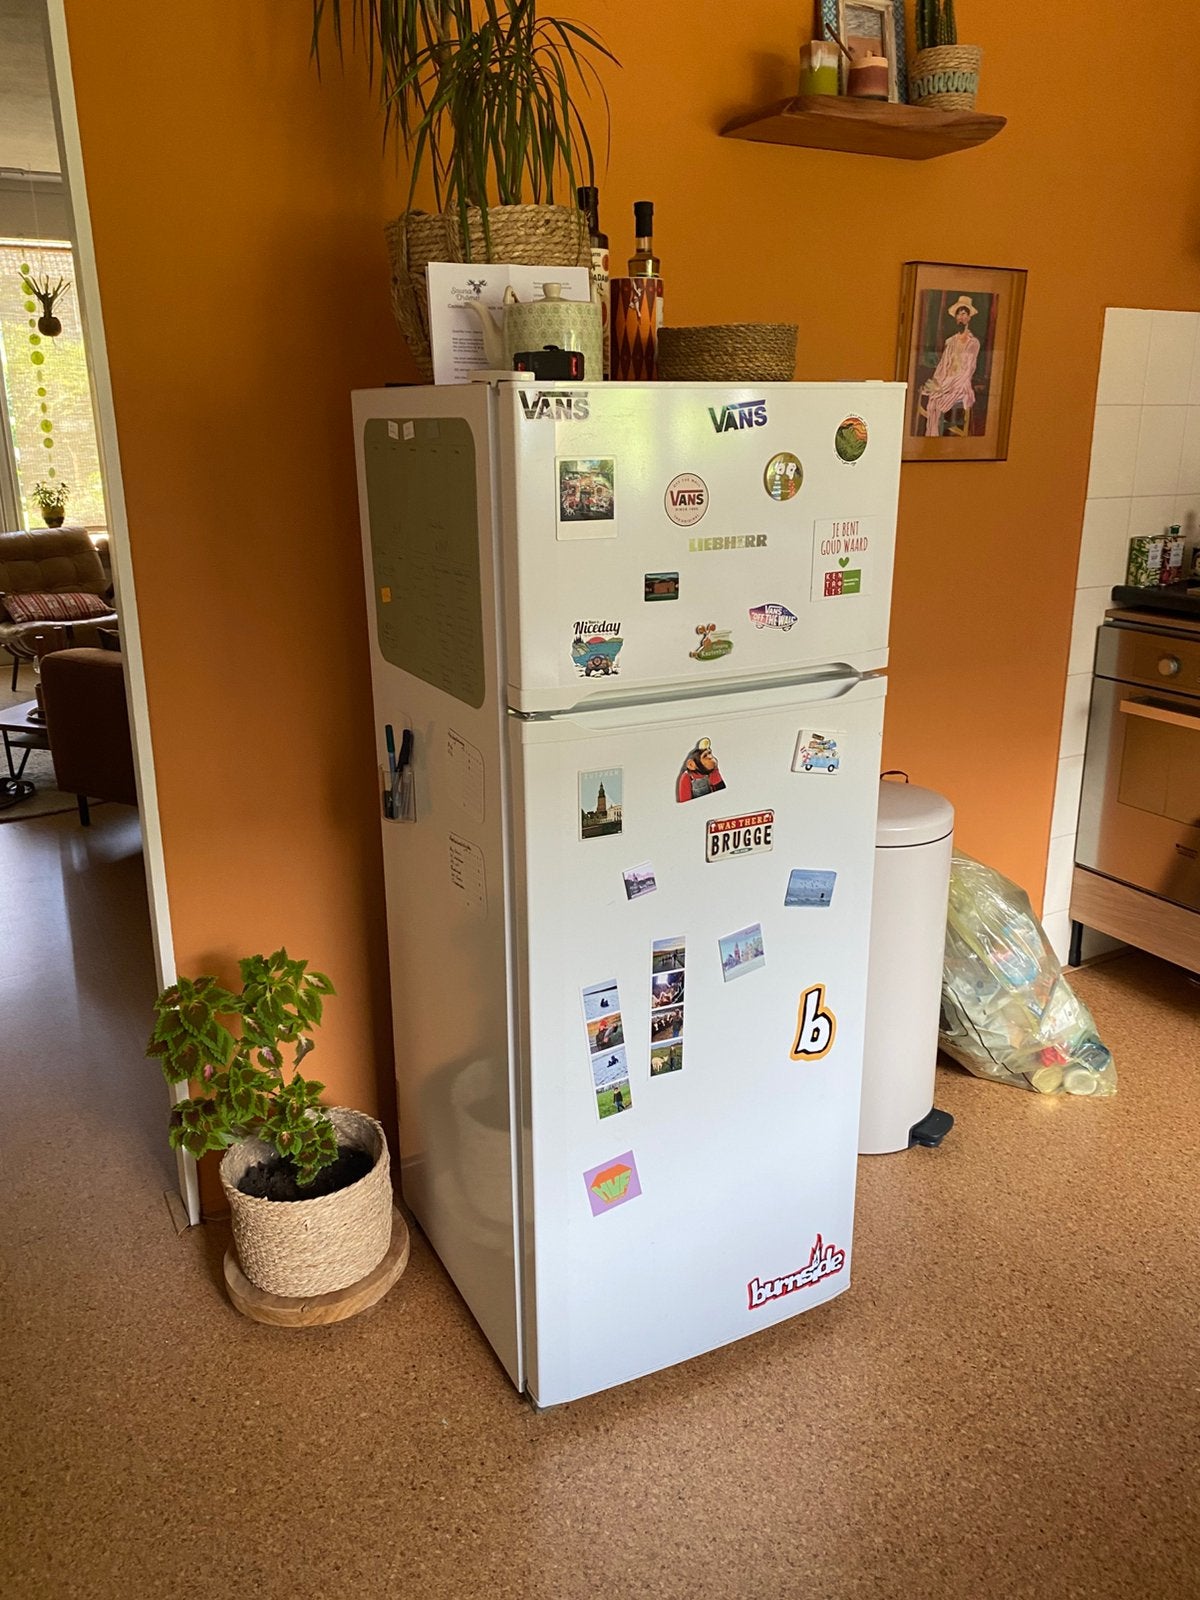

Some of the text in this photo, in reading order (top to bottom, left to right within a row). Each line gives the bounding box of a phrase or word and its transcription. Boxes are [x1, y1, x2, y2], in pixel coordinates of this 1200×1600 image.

[518, 391, 590, 420] VANS
[708, 399, 768, 433] VANS
[670, 490, 704, 506] VANS
[832, 521, 859, 539] JE BENT
[689, 534, 767, 552] LIEBHERR
[821, 537, 868, 555] GOUD WAARD
[765, 605, 783, 615] VANS
[573, 620, 621, 635] Niceday
[718, 821, 736, 831] WAS
[711, 825, 772, 856] BRUGGE
[748, 1240, 845, 1309] burnside
